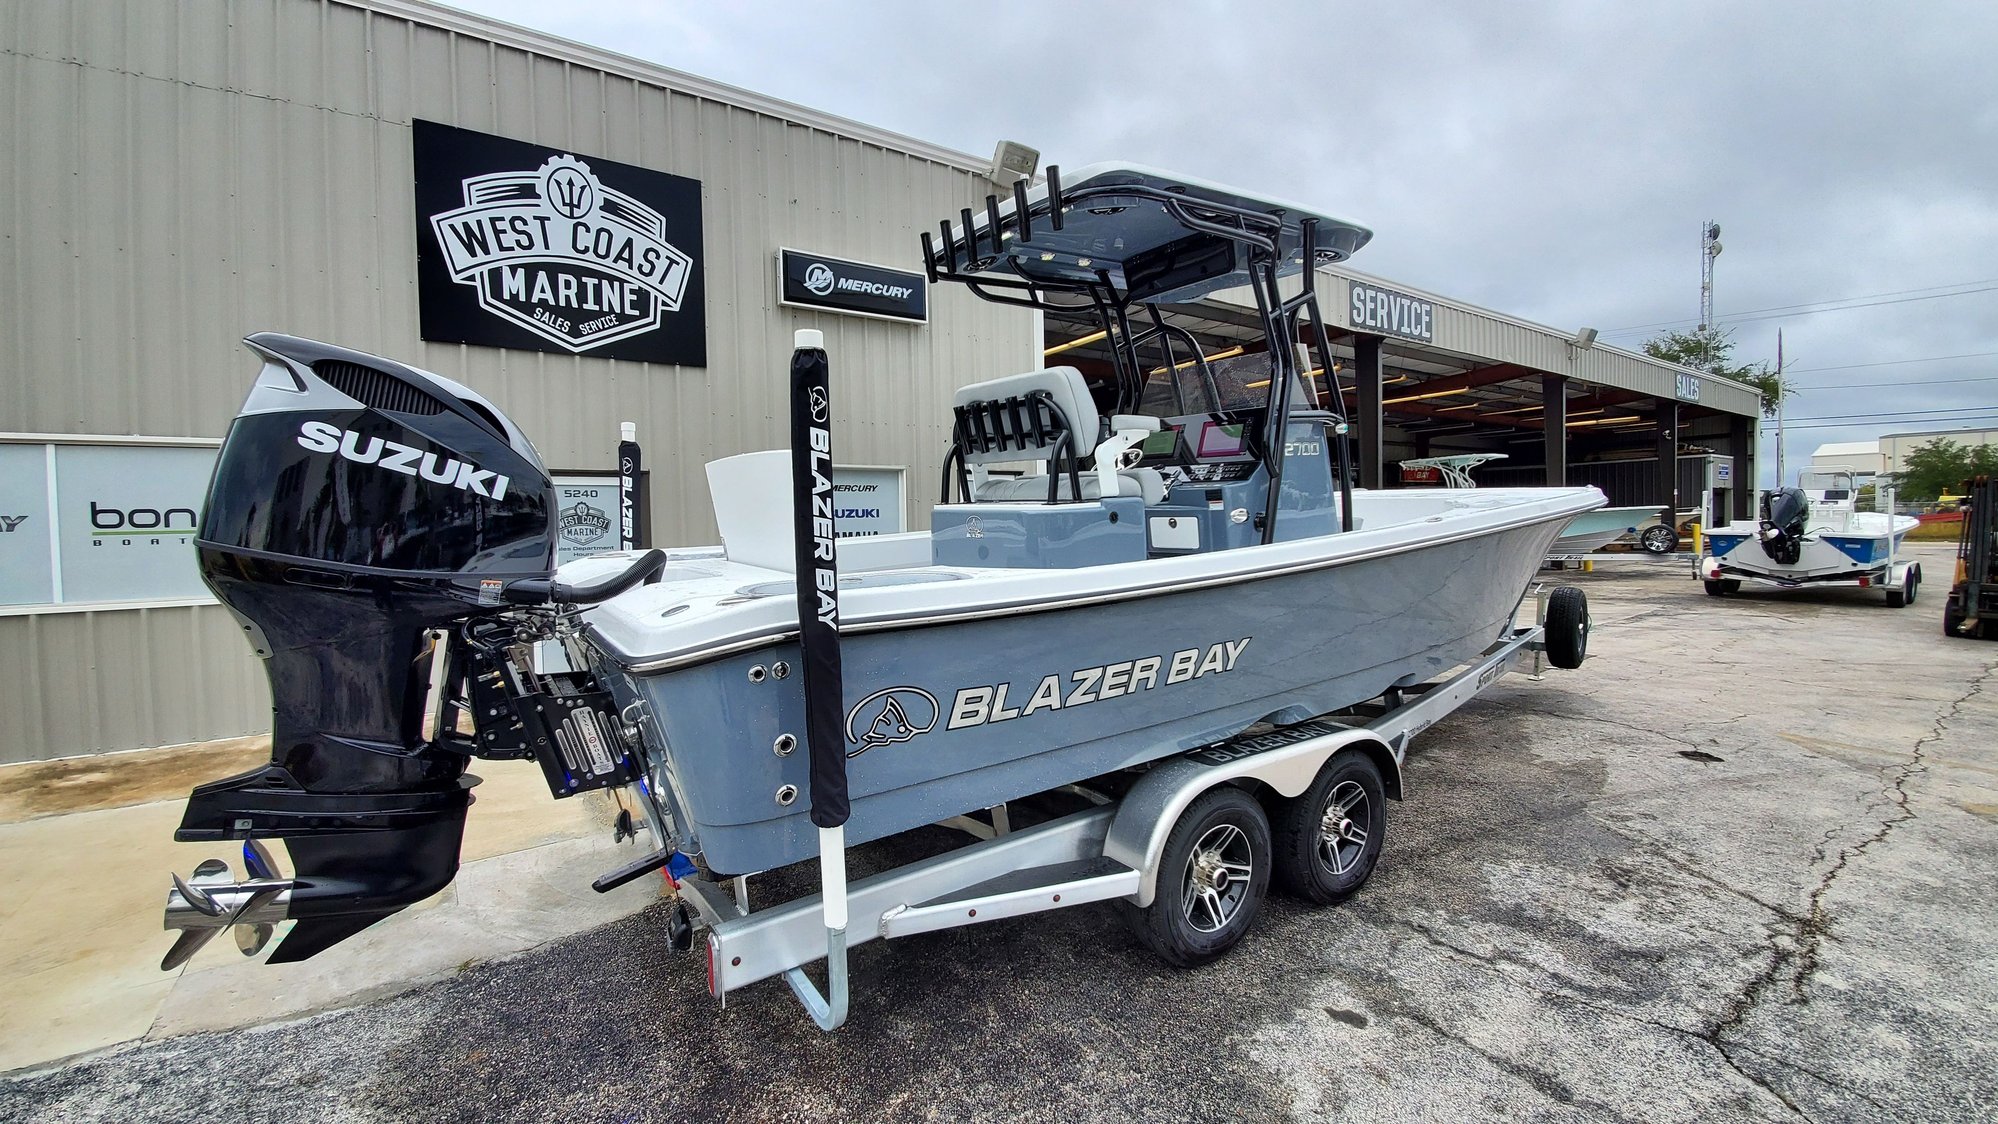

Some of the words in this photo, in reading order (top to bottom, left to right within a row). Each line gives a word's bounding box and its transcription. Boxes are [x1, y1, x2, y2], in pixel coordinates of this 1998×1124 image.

[448, 215, 551, 259] WEST
[571, 221, 681, 286] COAST
[502, 265, 640, 316] MARINE
[837, 277, 913, 299] MERCURY
[533, 307, 571, 333] SALES
[579, 314, 619, 336] SERVICE
[1352, 286, 1431, 338] SERVICE
[1676, 374, 1699, 400] SALES
[297, 420, 510, 501] SUZUKI
[1284, 441, 1320, 456] 2700
[564, 489, 598, 498] 5240
[622, 475, 633, 538] BLAZER
[809, 426, 834, 562] BLAZER
[834, 508, 880, 518] UZUKI
[566, 527, 598, 537] MARINE
[581, 515, 609, 528] COAST
[815, 567, 838, 632] BAY
[945, 655, 1162, 731] BLAZER
[1165, 637, 1252, 686] BAY
[1202, 731, 1297, 763] BLAZER
[1287, 722, 1332, 741] BAY
